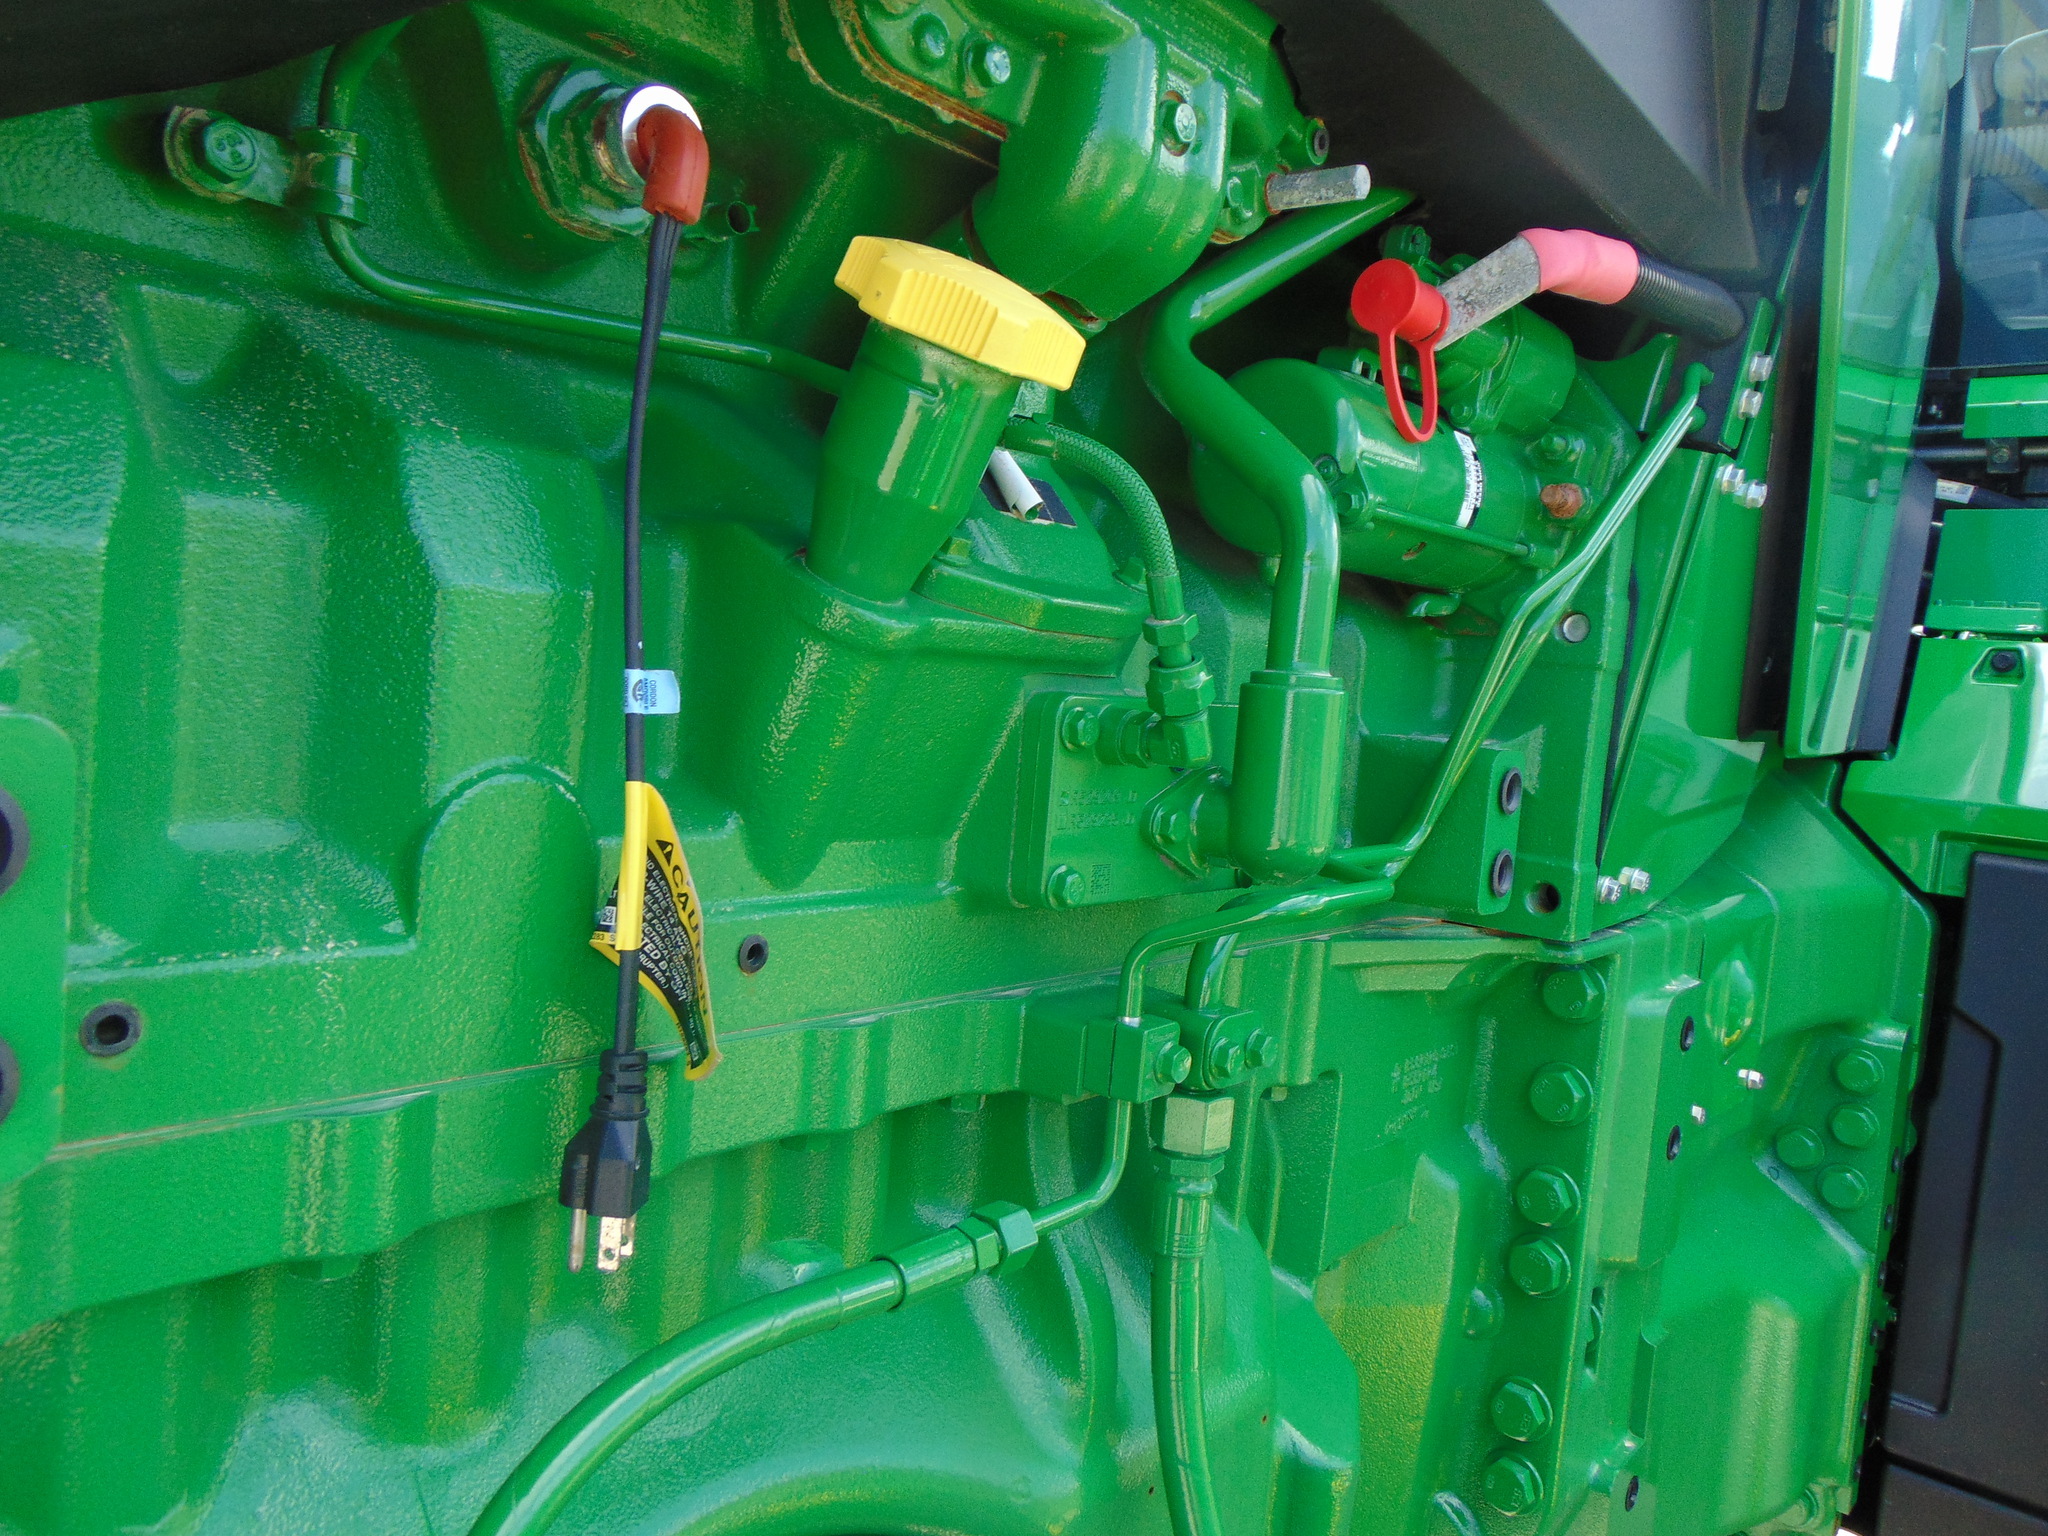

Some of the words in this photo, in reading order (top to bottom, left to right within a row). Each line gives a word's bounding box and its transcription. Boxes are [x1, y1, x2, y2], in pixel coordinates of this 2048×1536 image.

[649, 680, 657, 707] CORDON
[653, 870, 678, 921] ELECTRICAL
[645, 895, 678, 946] ELECTRICAL
[651, 918, 667, 937] FOR
[642, 922, 670, 960] ECTRICAL
[669, 963, 683, 987] CORD
[659, 960, 671, 977] BY
